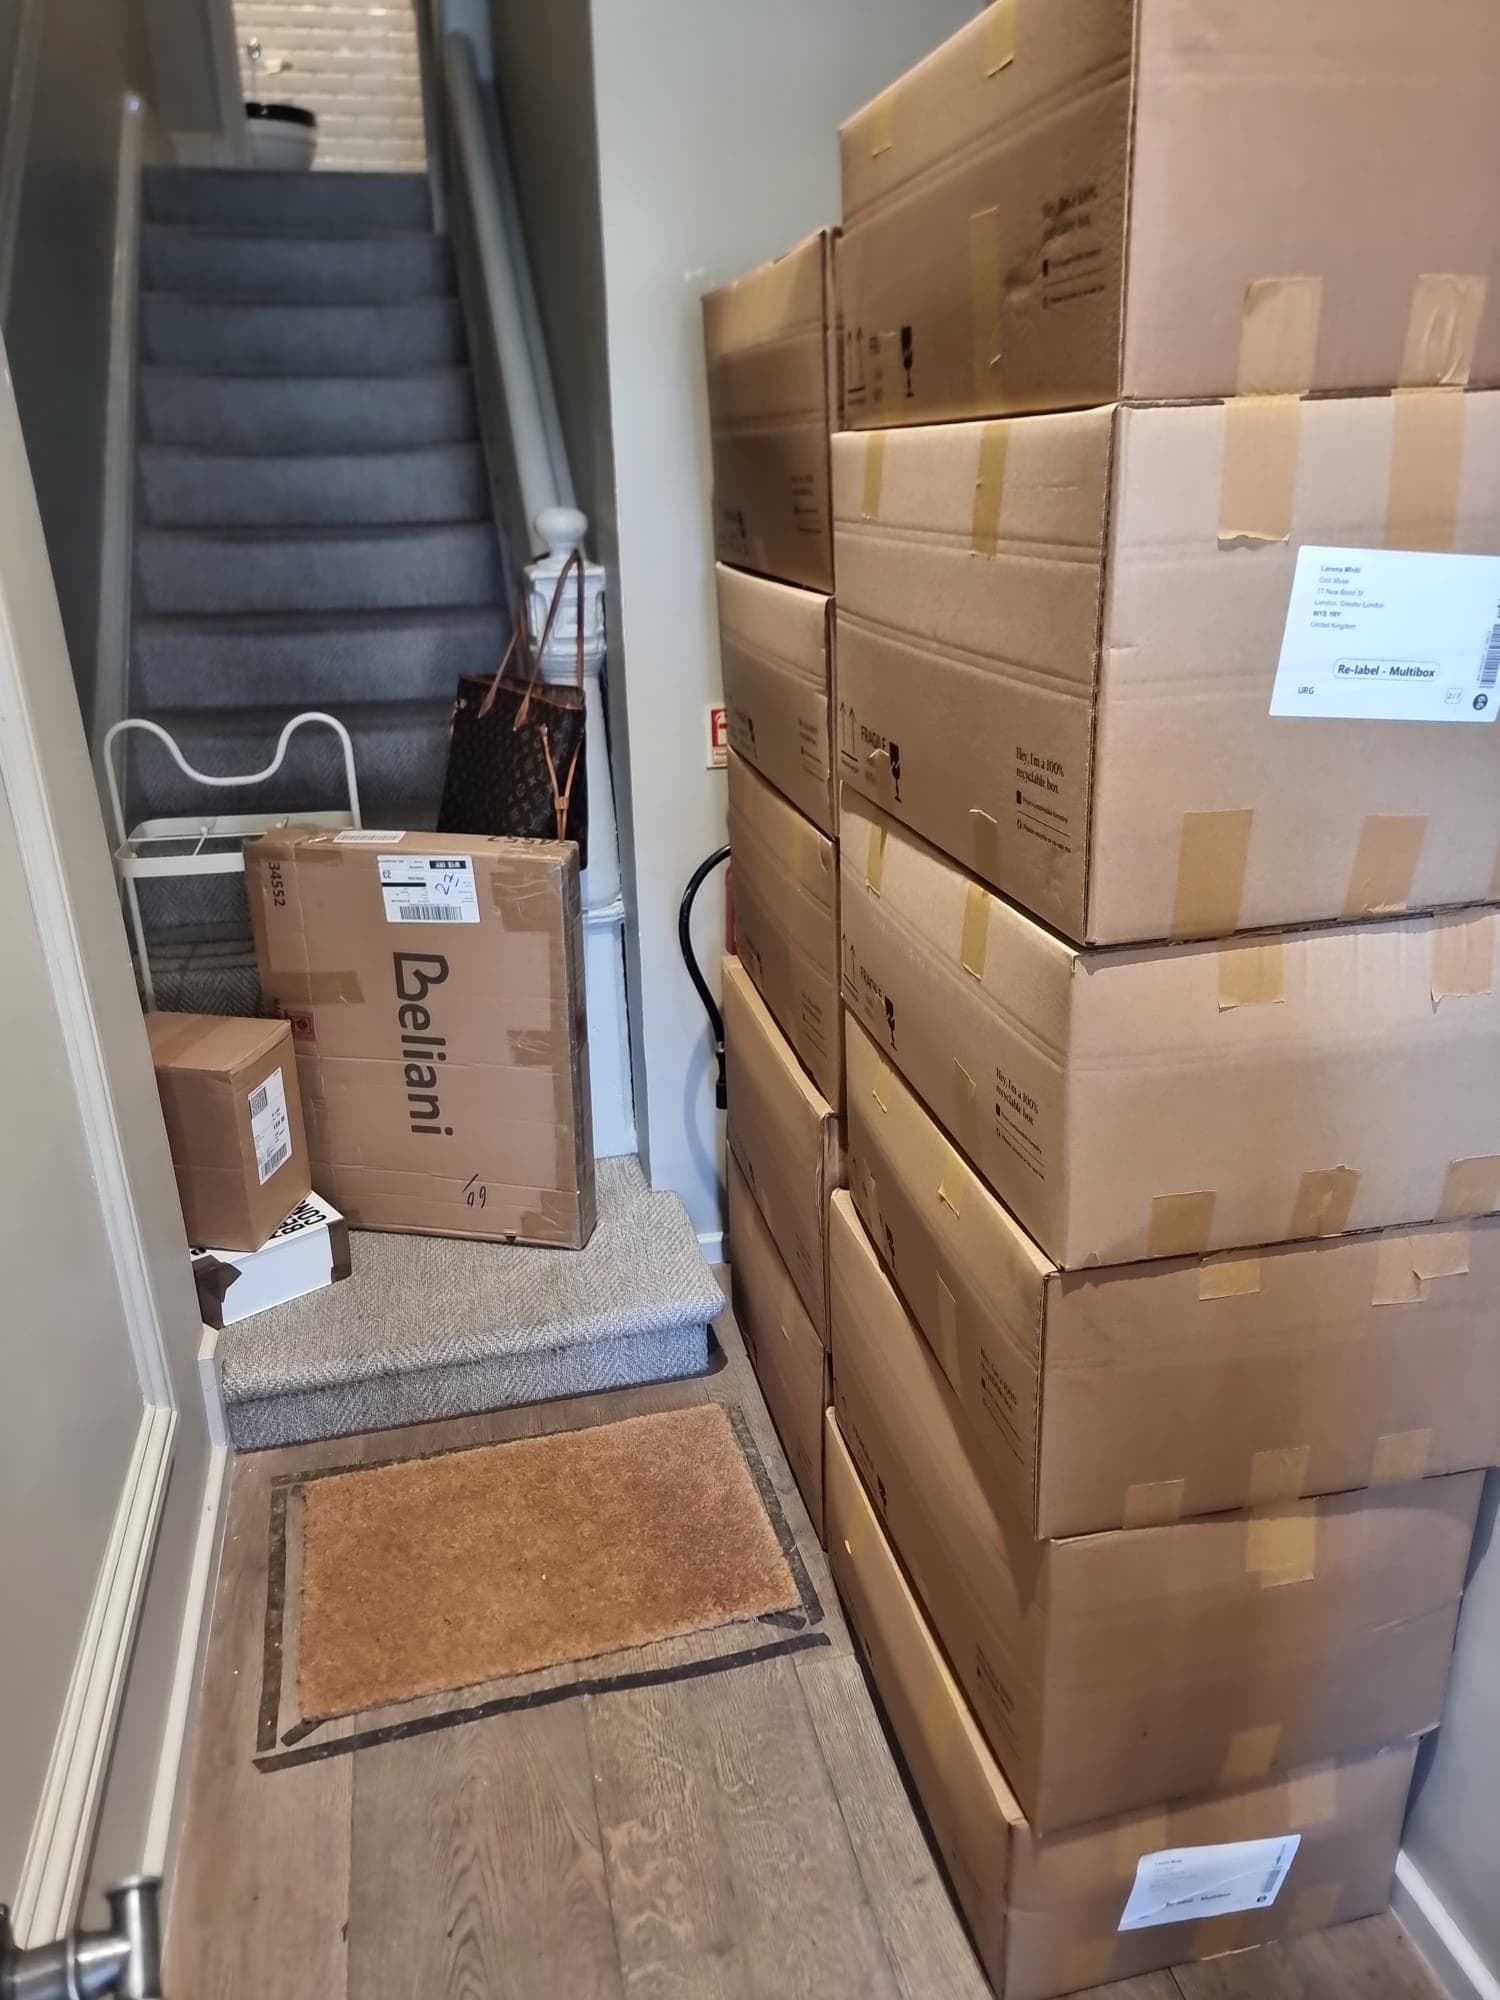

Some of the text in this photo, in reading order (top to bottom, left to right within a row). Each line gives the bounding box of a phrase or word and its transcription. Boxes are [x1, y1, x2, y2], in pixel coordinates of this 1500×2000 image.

[1338, 664, 1380, 676] Re-label
[1389, 666, 1435, 678] Multibox
[1016, 767, 1059, 794] recyclable box
[1046, 760, 1064, 778] 100%
[269, 862, 286, 906] 34552
[393, 951, 454, 1136] Beliani
[996, 1084, 1034, 1126] recyclable box
[1022, 1092, 1038, 1115] 100%
